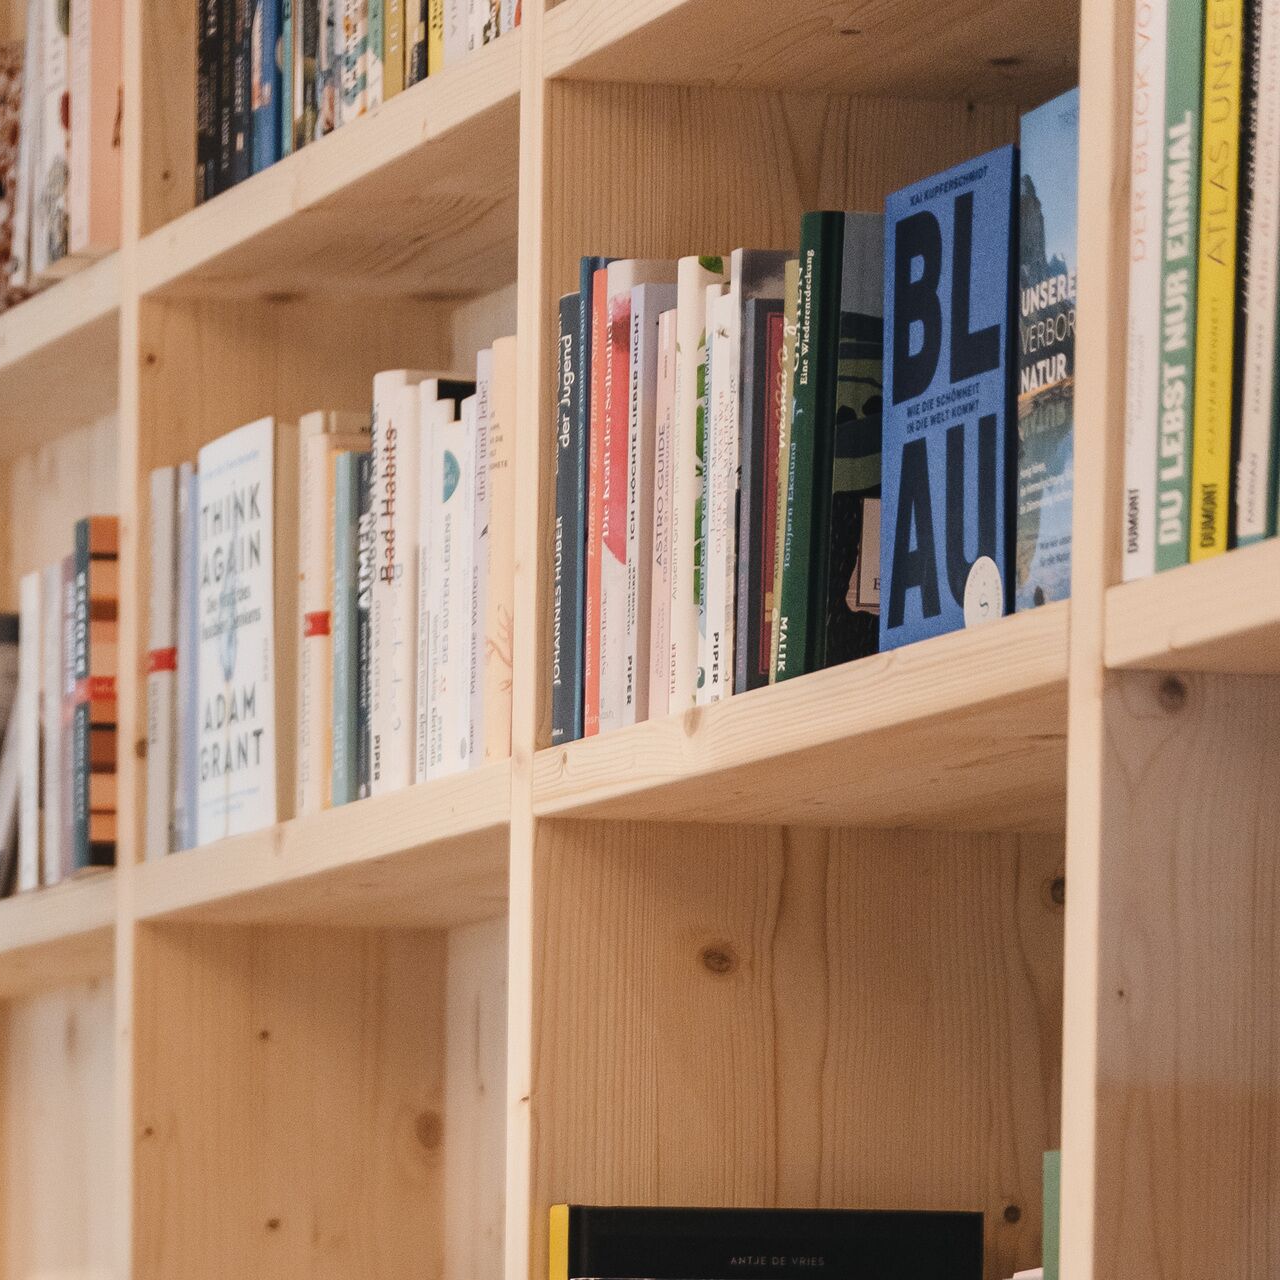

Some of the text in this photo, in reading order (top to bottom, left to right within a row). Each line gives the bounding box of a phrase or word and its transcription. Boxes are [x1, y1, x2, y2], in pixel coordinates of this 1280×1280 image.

[1206, 139, 1230, 267] ATLAS
[799, 248, 815, 386] Eine Wiederentdeckung
[892, 190, 1002, 408] BL
[1158, 109, 1193, 546] DU LEBST NUR EINMAL
[559, 332, 576, 449] der Jugend
[631, 370, 639, 428] LIEBER
[906, 383, 980, 418] WIE DIE SCHÖNHEIT
[1020, 352, 1067, 395] NATUR
[476, 379, 489, 501] dich und lebe!
[602, 303, 614, 537] Die Kraft der Selbstliebe
[930, 400, 980, 426] WELT KOMMT
[379, 426, 398, 517] Habits
[630, 431, 638, 504] MÖCHTE
[655, 423, 666, 567] ASTRO GUIDE
[200, 481, 262, 541] THINK
[783, 441, 797, 568] Torbjørn Ekelund
[887, 412, 998, 630] AU
[1126, 488, 1140, 554] DUMONT
[1199, 482, 1218, 548] DUMONT
[200, 528, 262, 590] AGAIN
[378, 529, 396, 583] Bad
[441, 512, 451, 664] DES GUTEN LEBENS
[671, 549, 679, 600] Anselm
[552, 515, 564, 685] JOHANNES HUBER
[710, 630, 721, 684] PIPER
[776, 616, 789, 673] MALIK
[204, 680, 257, 733] ADAM
[200, 726, 266, 785] GRANT
[373, 734, 381, 781] PIPER
[729, 1255, 825, 1268] ANTJE DE VRIES
